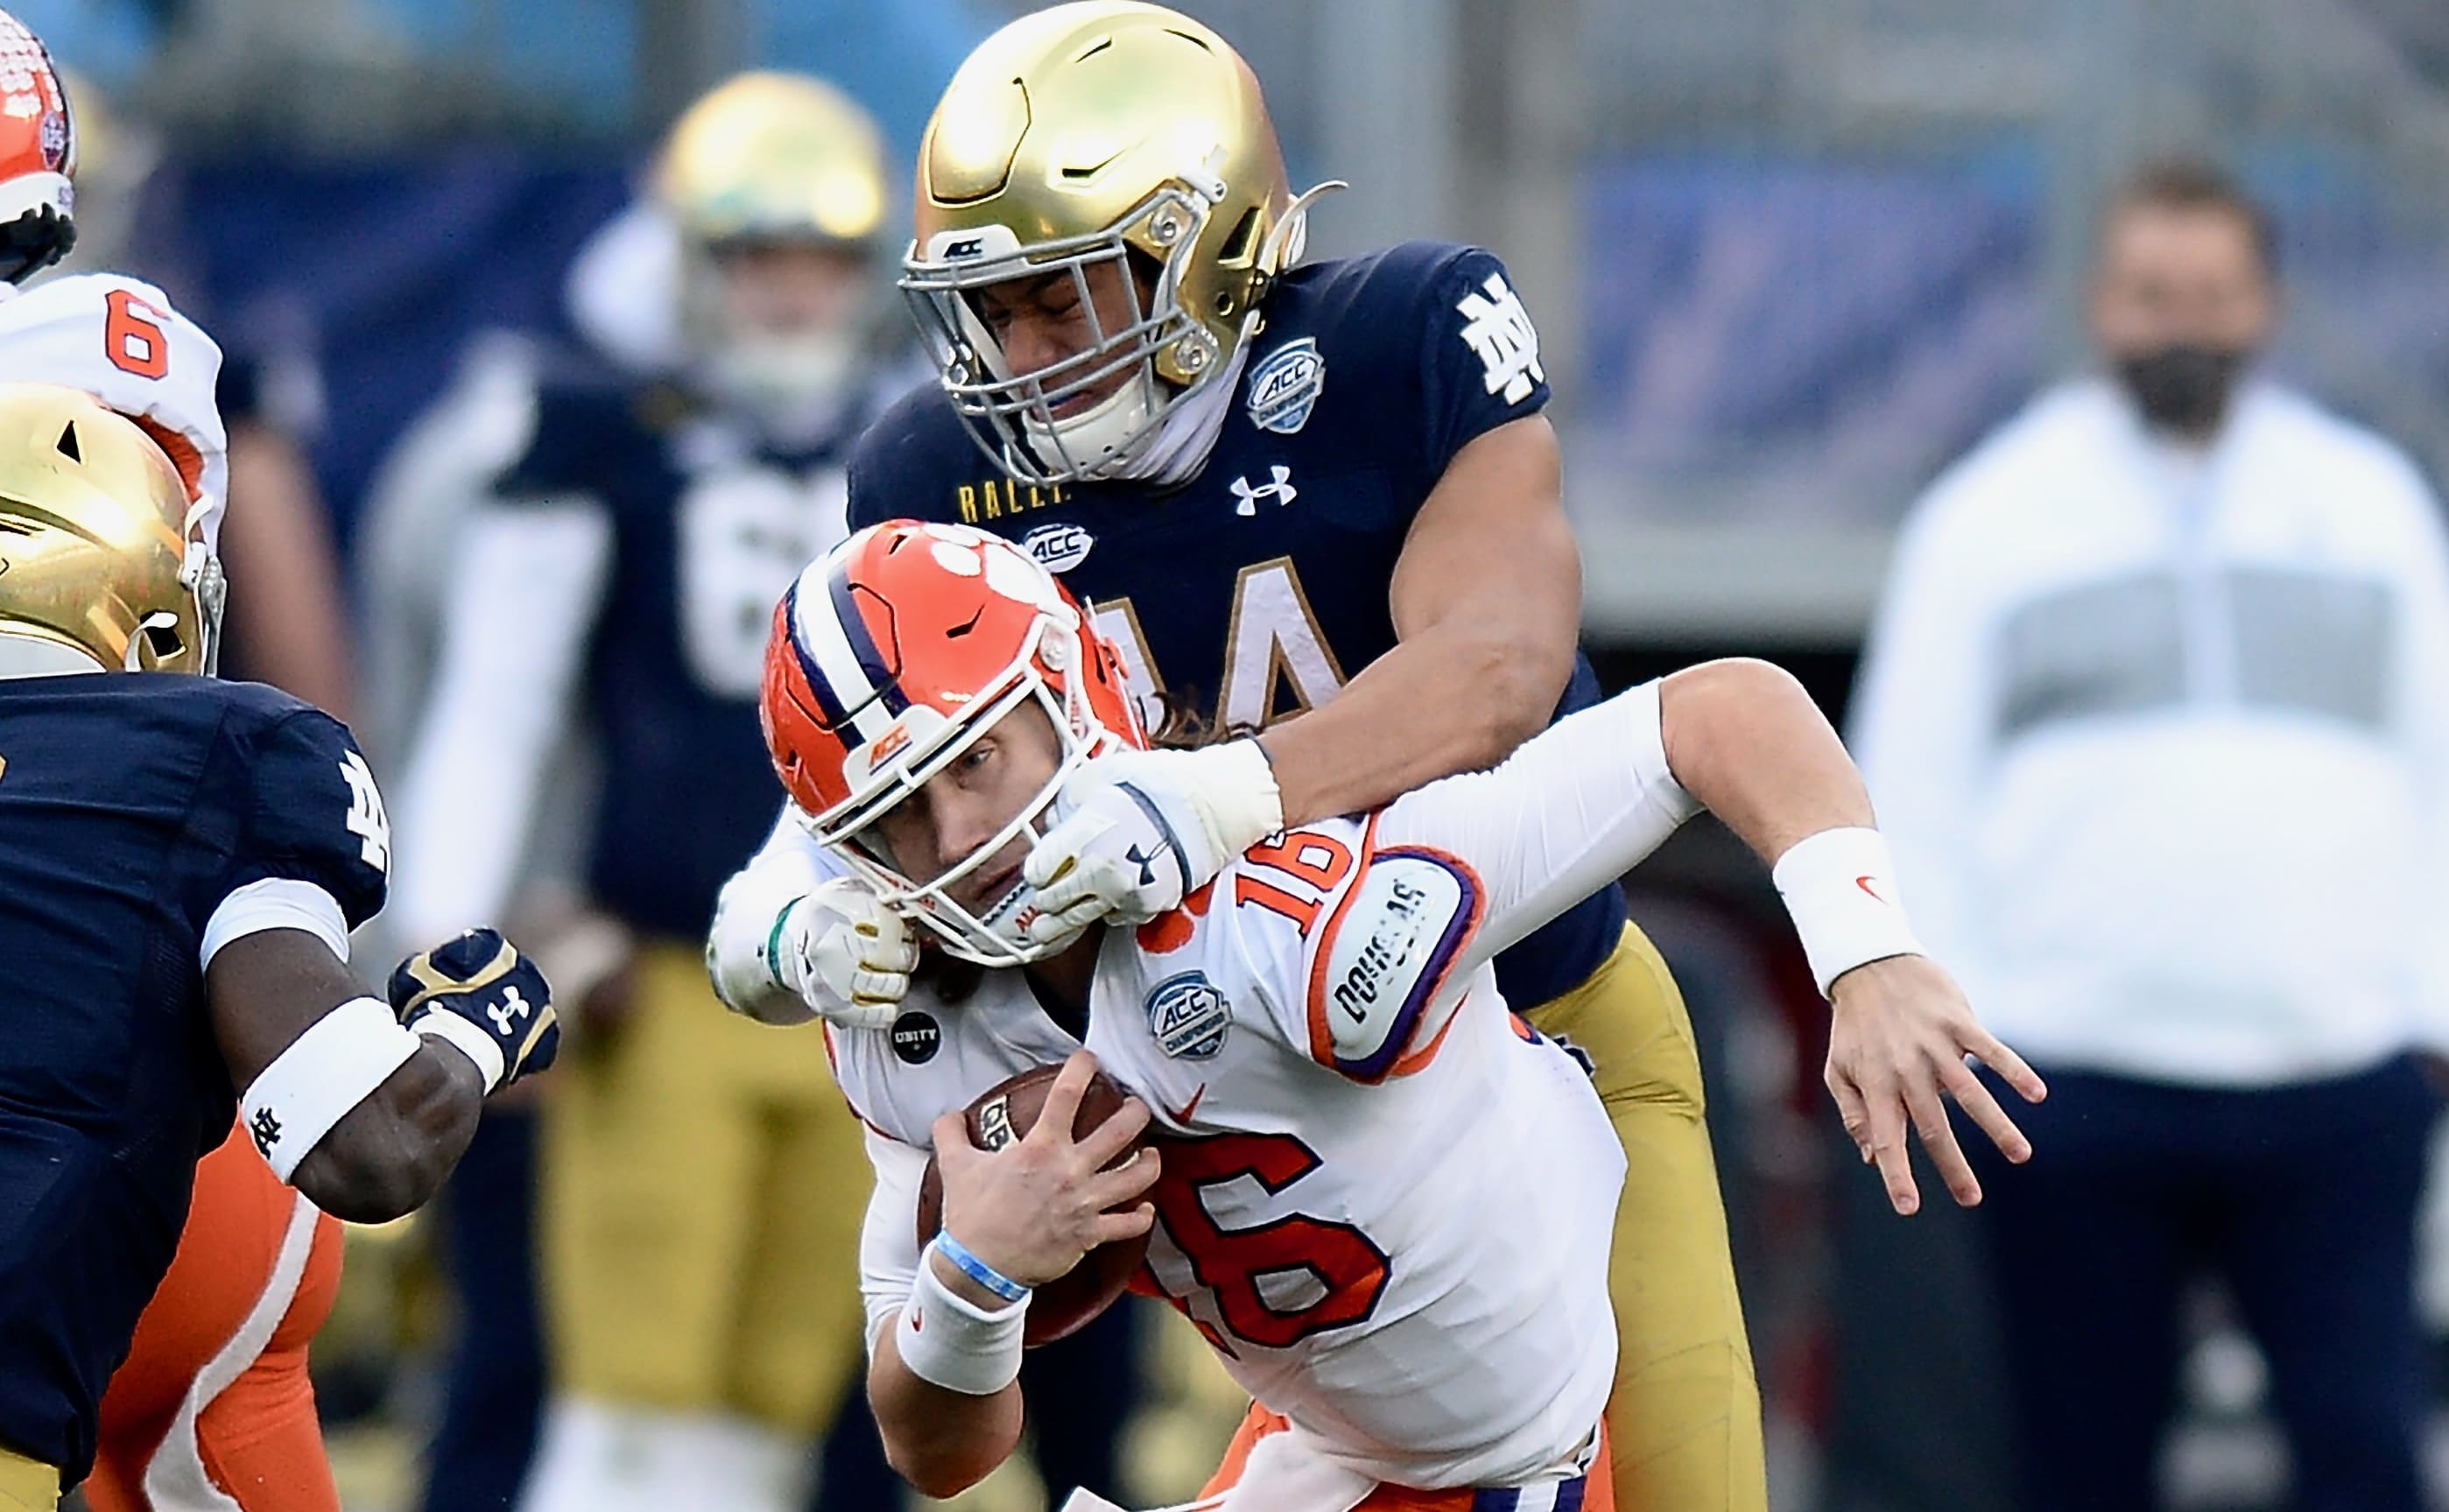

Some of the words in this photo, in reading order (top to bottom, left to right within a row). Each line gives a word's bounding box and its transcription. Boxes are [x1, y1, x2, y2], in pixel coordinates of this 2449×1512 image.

[104, 289, 172, 381] 6
[1262, 359, 1306, 401] ACC
[1032, 530, 1081, 559] ACC
[1235, 831, 1354, 944] 16
[1162, 988, 1207, 1031] ACC
[894, 1028, 937, 1044] UNITY
